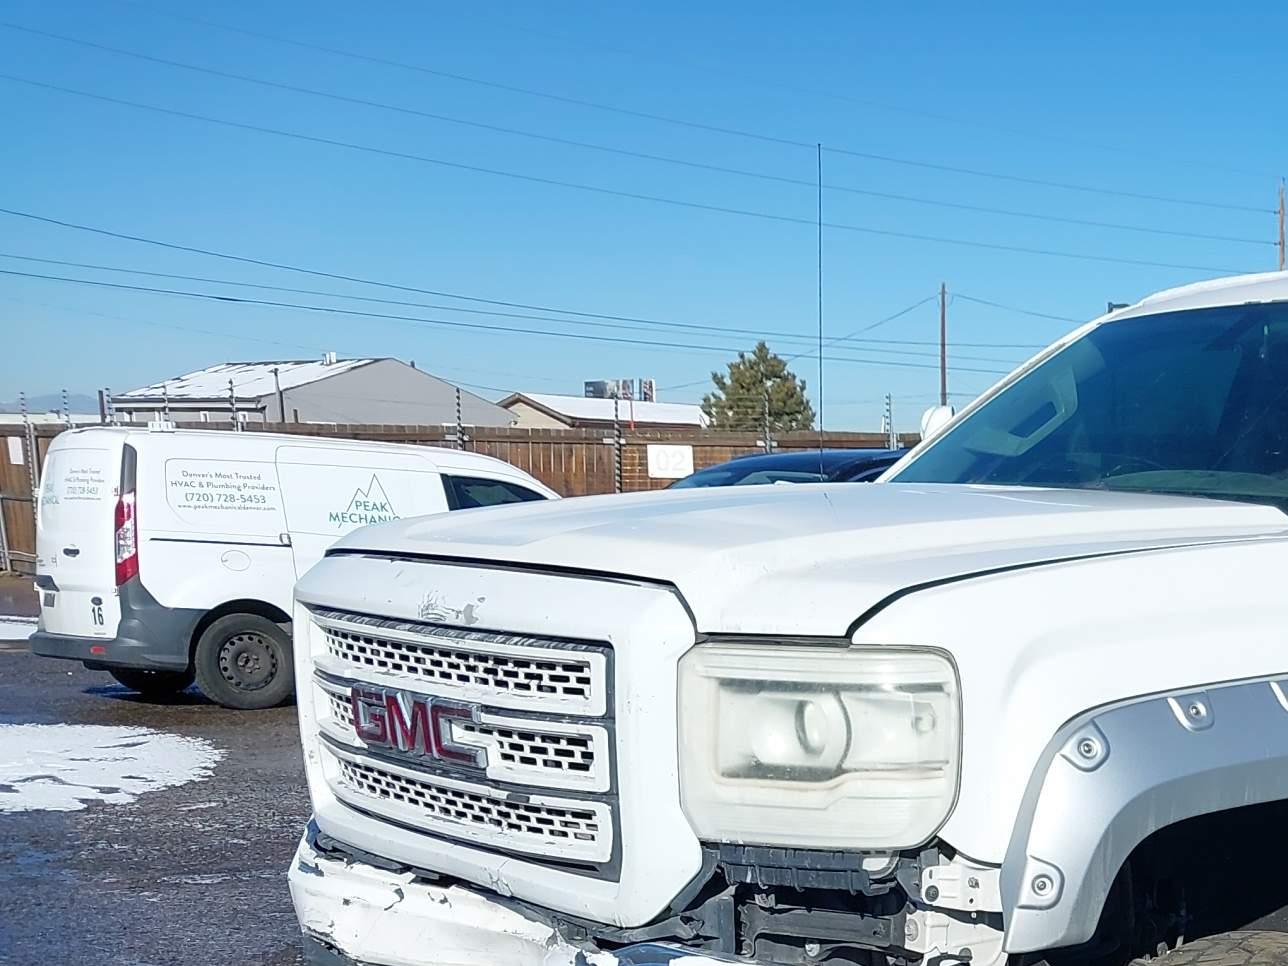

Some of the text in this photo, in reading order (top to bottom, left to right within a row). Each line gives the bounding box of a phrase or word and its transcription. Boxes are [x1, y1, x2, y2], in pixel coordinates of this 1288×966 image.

[181, 470, 261, 481] Denver's Most Trusted
[171, 480, 196, 488] HVAC
[206, 481, 242, 492] Plumbing
[243, 483, 276, 492] Providers
[185, 492, 267, 504] (720) 728-5453
[355, 500, 389, 512] PEAK
[91, 606, 104, 625] 16
[351, 682, 488, 768] GMC
